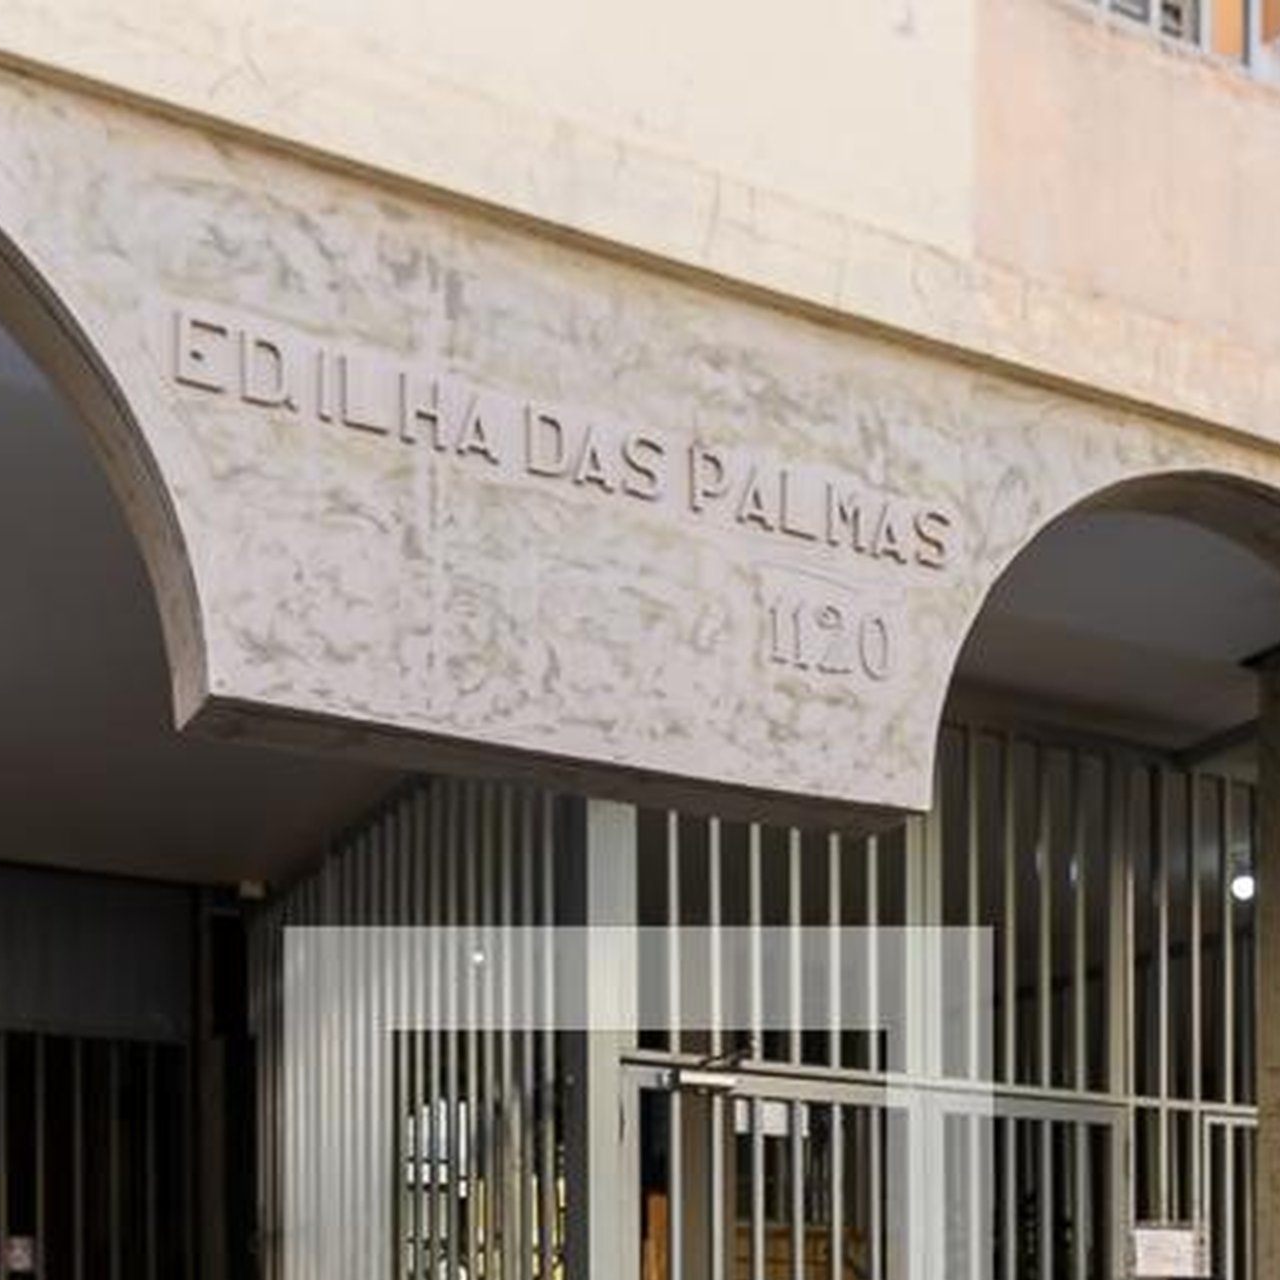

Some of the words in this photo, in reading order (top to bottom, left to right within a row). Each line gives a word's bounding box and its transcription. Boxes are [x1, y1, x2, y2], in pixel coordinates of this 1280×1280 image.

[316, 347, 500, 465] ILHA
[523, 400, 664, 501] DAS
[687, 440, 951, 570] PALMAS
[768, 597, 891, 682] 1120
